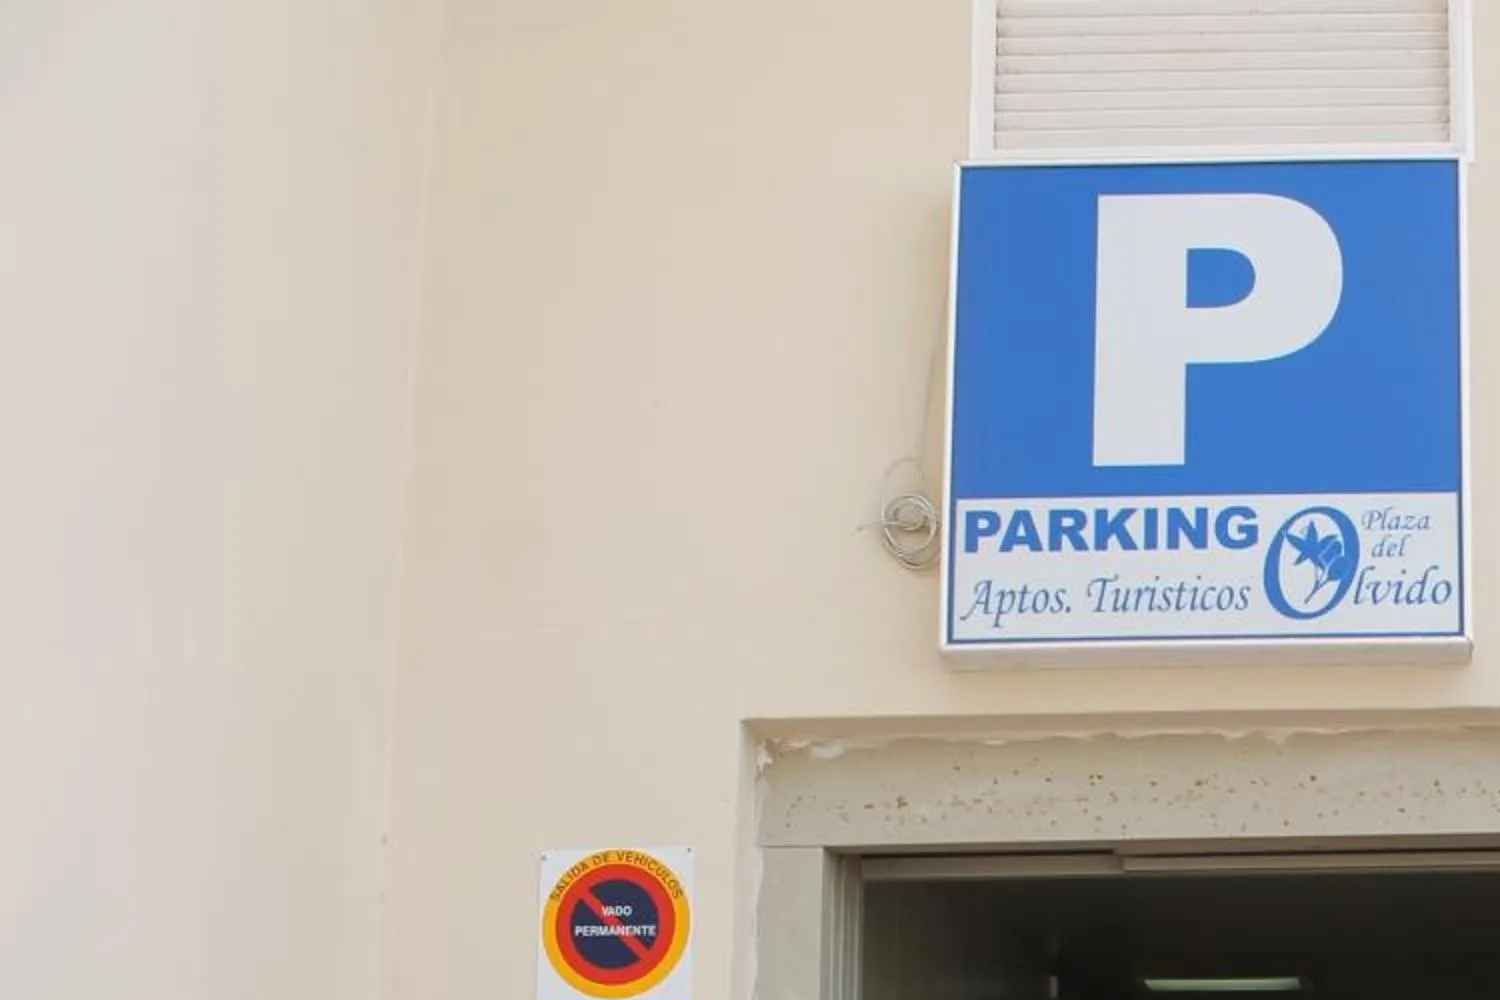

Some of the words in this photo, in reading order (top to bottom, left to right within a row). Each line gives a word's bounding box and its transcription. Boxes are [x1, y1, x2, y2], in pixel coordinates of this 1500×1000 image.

[1093, 193, 1343, 466] P
[964, 506, 1259, 552] PARKING
[1361, 509, 1430, 532] Plaza
[1371, 534, 1407, 558] del
[961, 579, 1072, 628] Aptos.
[1086, 574, 1250, 614] Turisticos
[549, 861, 590, 900] SALIDA
[592, 851, 609, 865] DE
[601, 905, 633, 917] VADO
[575, 925, 656, 937] PERMANENTE
